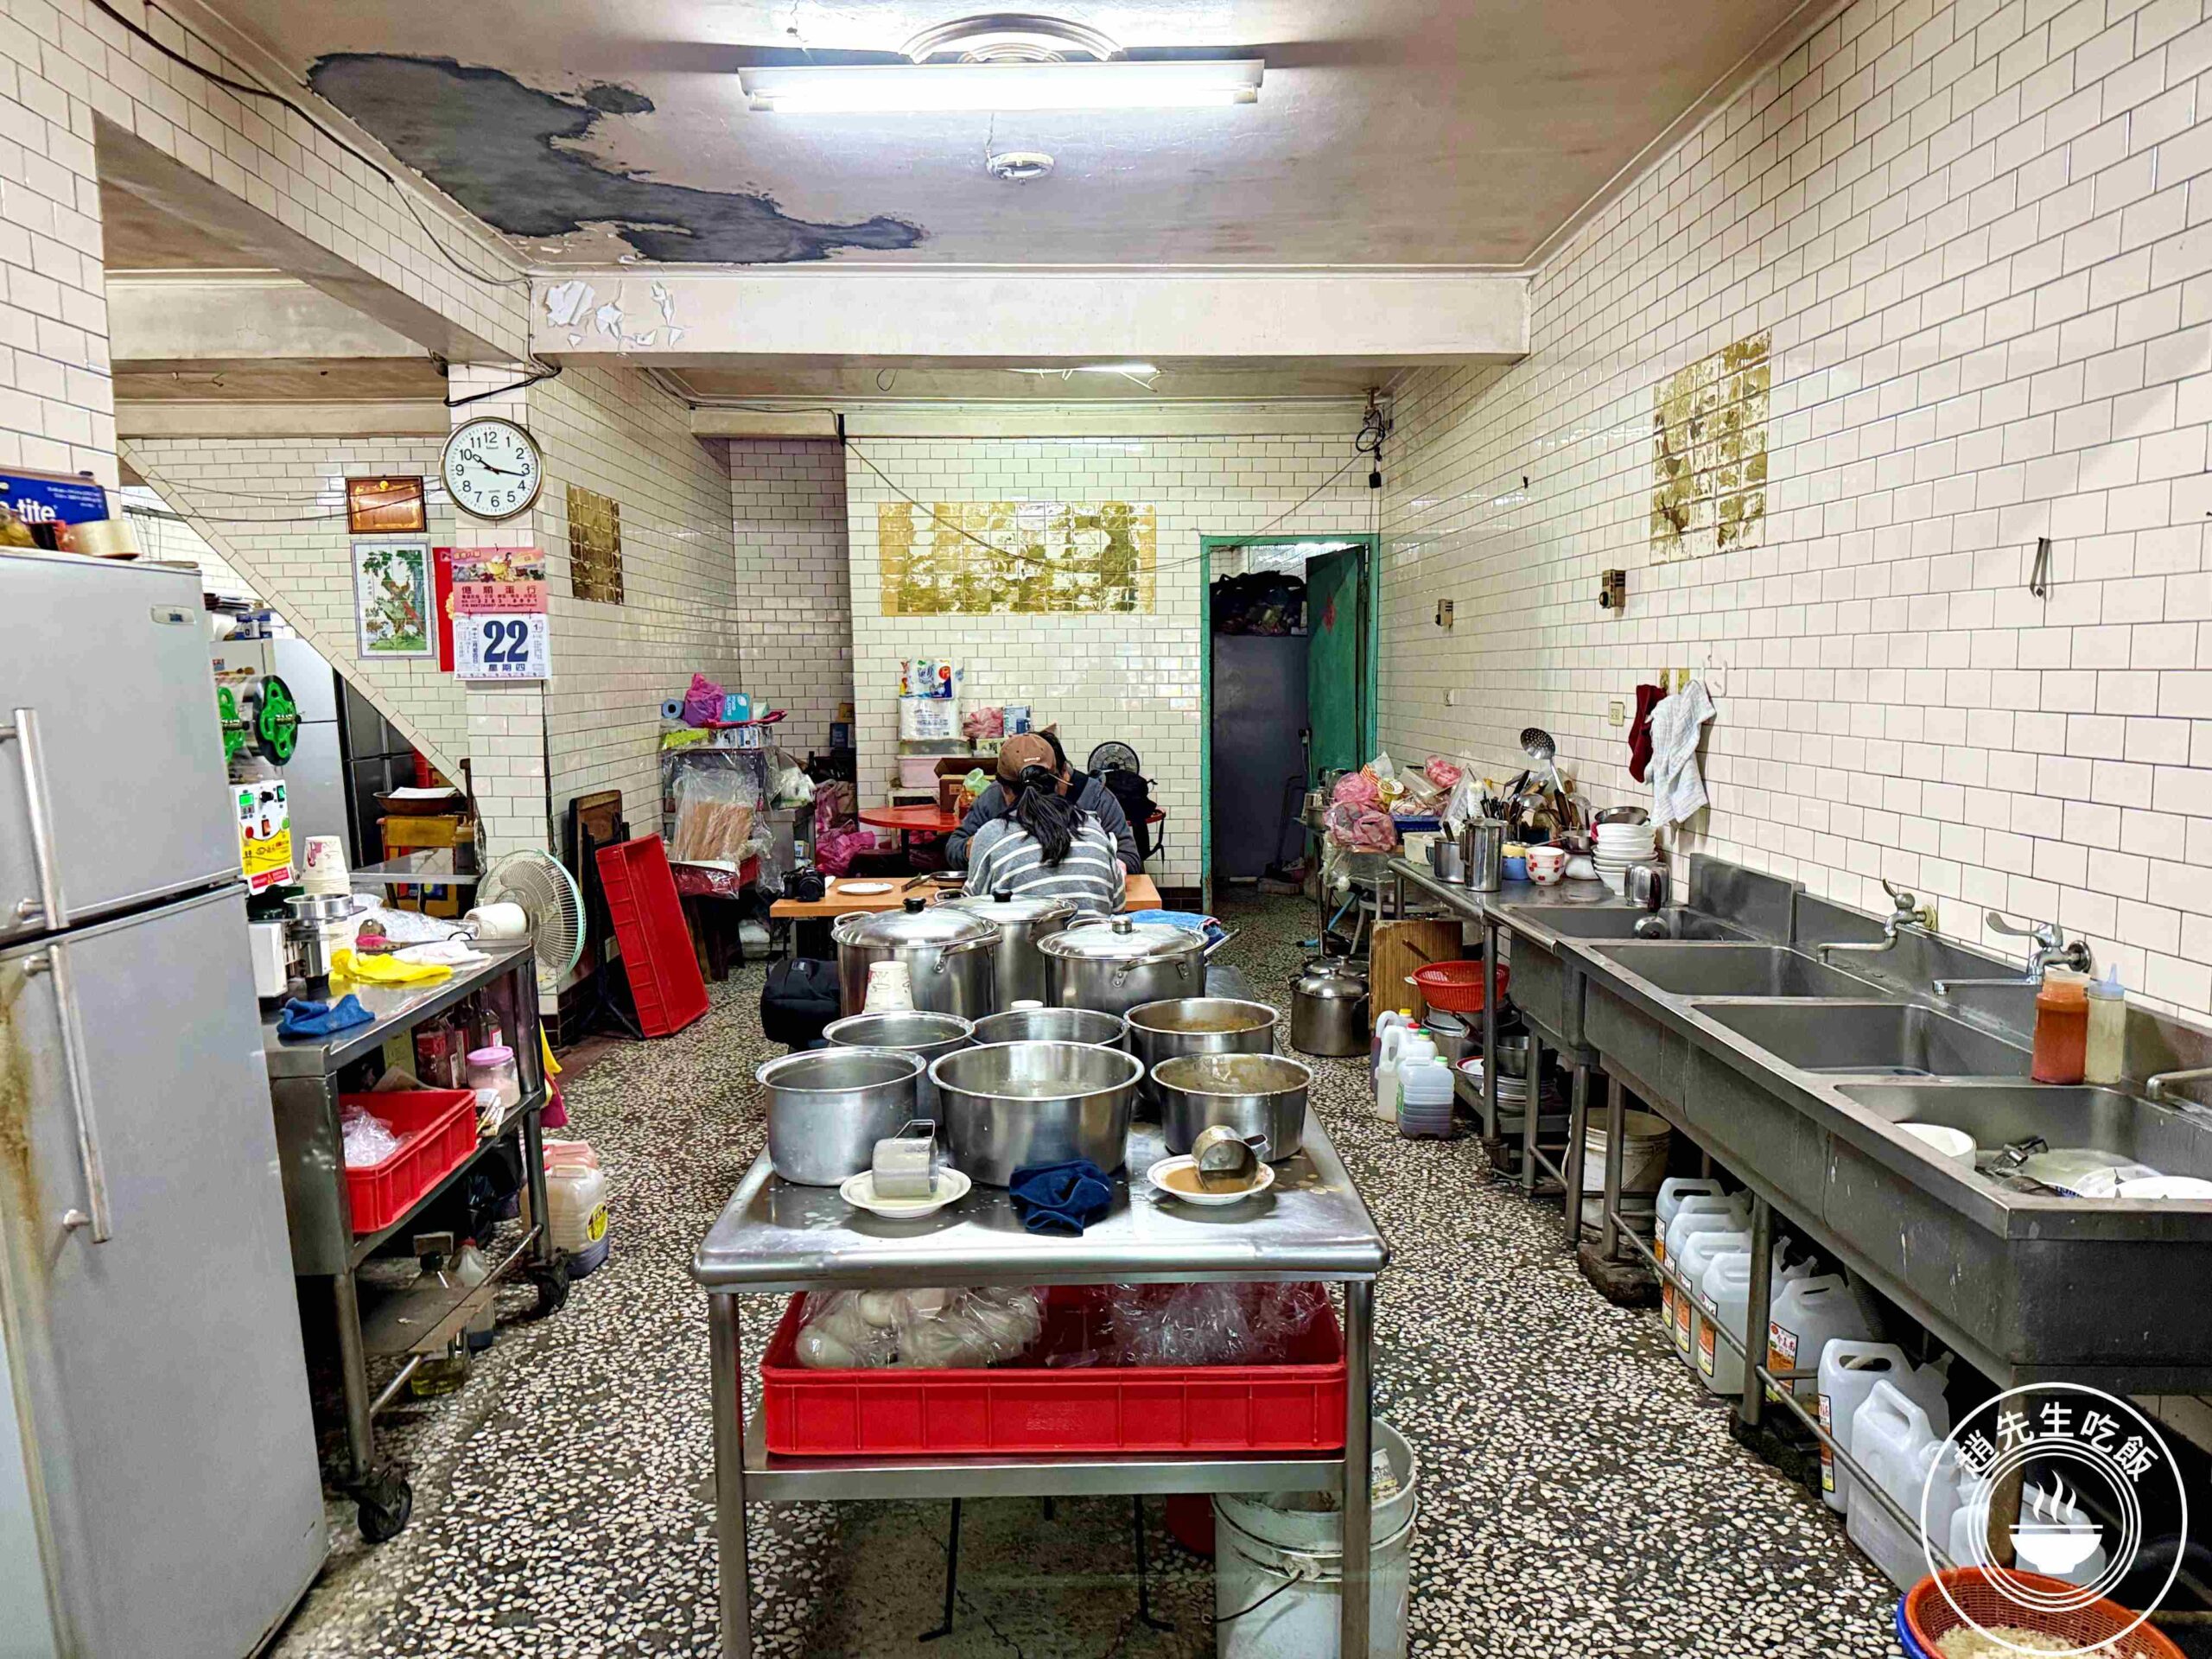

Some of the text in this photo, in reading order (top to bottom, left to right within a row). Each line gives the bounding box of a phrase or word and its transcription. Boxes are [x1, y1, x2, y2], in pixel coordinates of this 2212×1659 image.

[470, 436, 481, 448] 11
[484, 431, 497, 443] 12
[505, 436, 511, 448] 1
[459, 448, 473, 461] 10
[515, 448, 524, 460] 2
[455, 464, 465, 476] 9
[521, 463, 531, 475] 3
[462, 480, 472, 493] 8
[518, 480, 525, 491] 4
[474, 491, 482, 503] 7
[491, 495, 500, 507] 6
[506, 491, 516, 503] 5
[483, 620, 529, 663] 22
